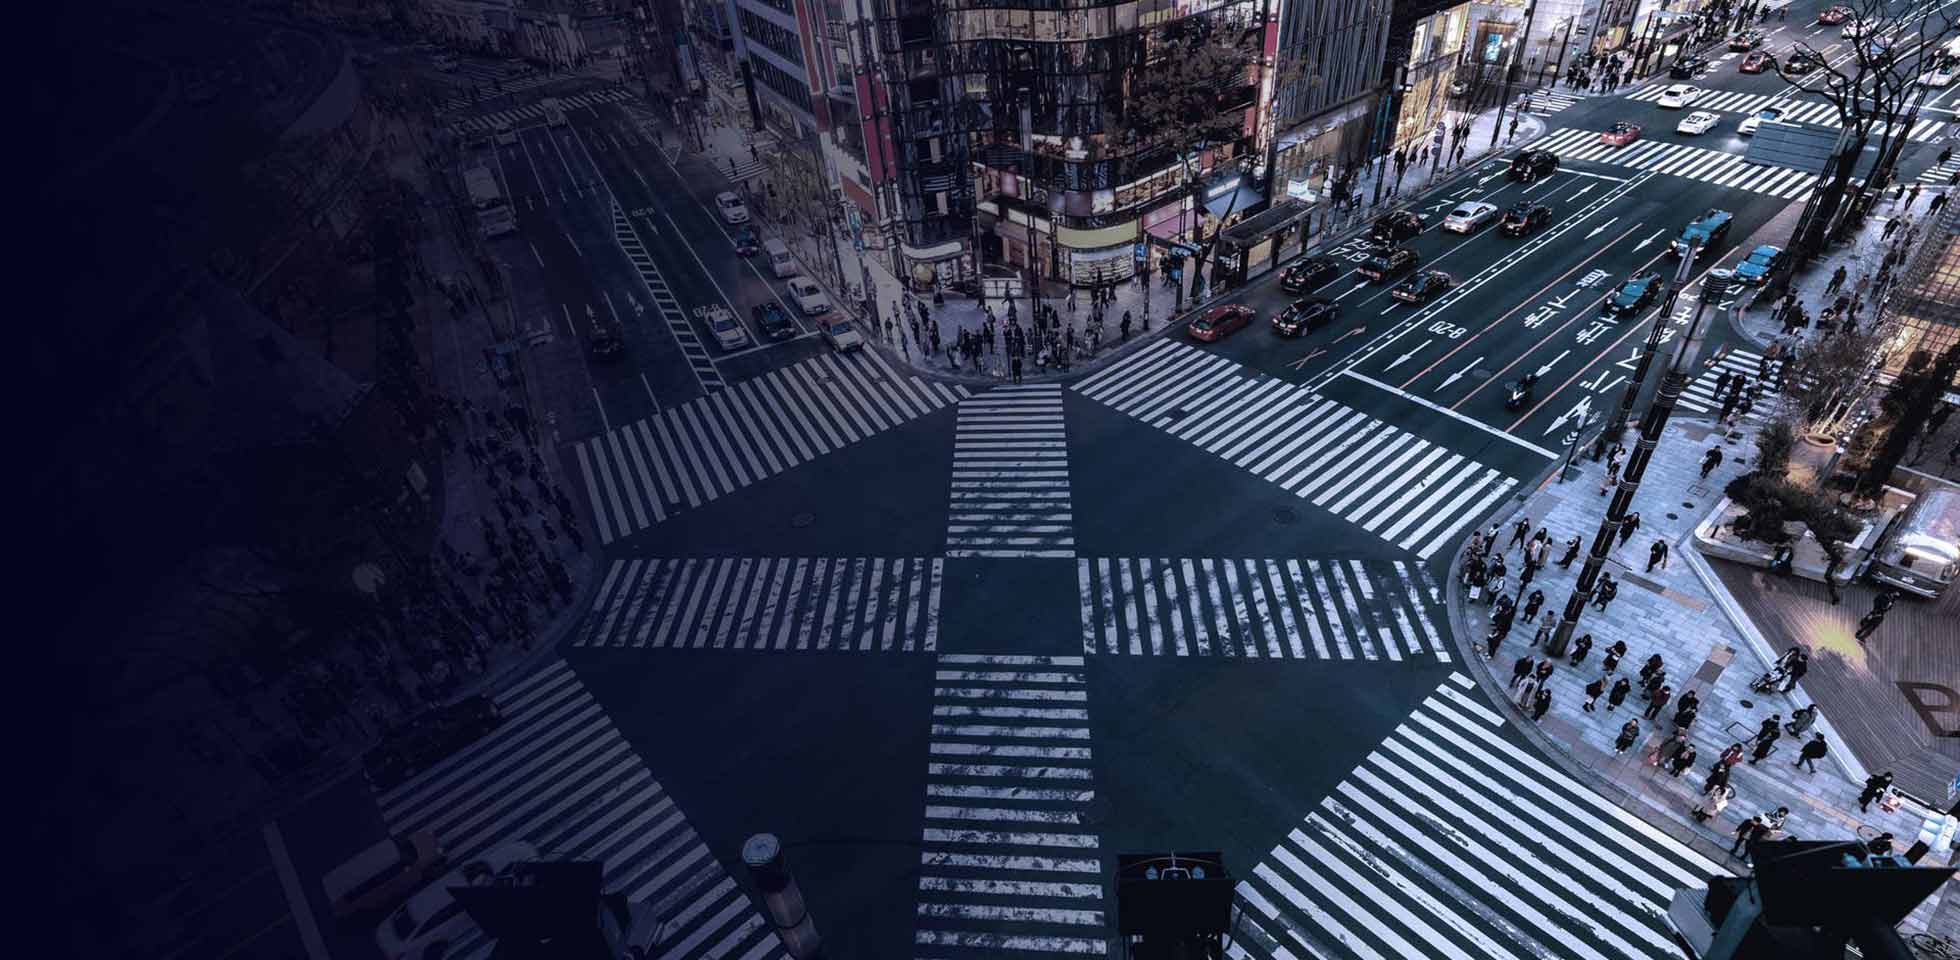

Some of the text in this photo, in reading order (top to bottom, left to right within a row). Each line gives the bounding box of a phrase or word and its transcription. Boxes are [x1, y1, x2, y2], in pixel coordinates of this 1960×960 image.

[1524, 269, 1613, 328] 地下道
[1428, 320, 1467, 339] 8-20
[1576, 313, 1620, 345] 地下
